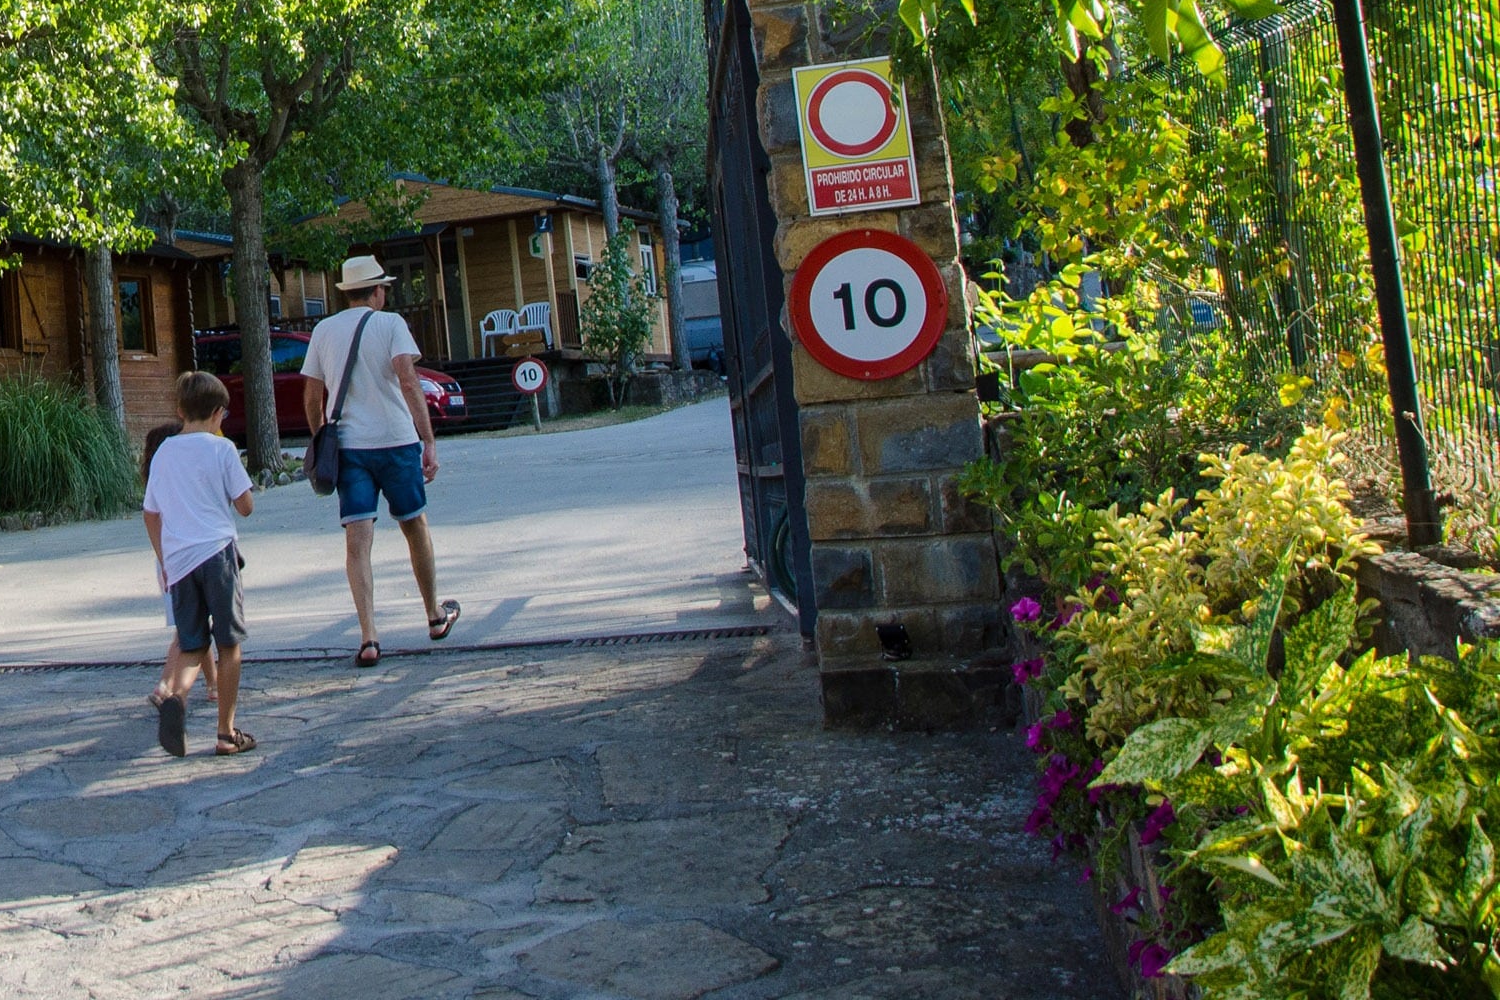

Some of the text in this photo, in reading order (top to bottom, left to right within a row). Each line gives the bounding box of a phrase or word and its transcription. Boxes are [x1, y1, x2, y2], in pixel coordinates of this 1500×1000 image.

[817, 164, 905, 187] PROHIBIDO CIRCULAR
[834, 184, 892, 203] DE 24 H. A 8 H.
[833, 278, 907, 331] 10
[520, 368, 538, 383] 10
